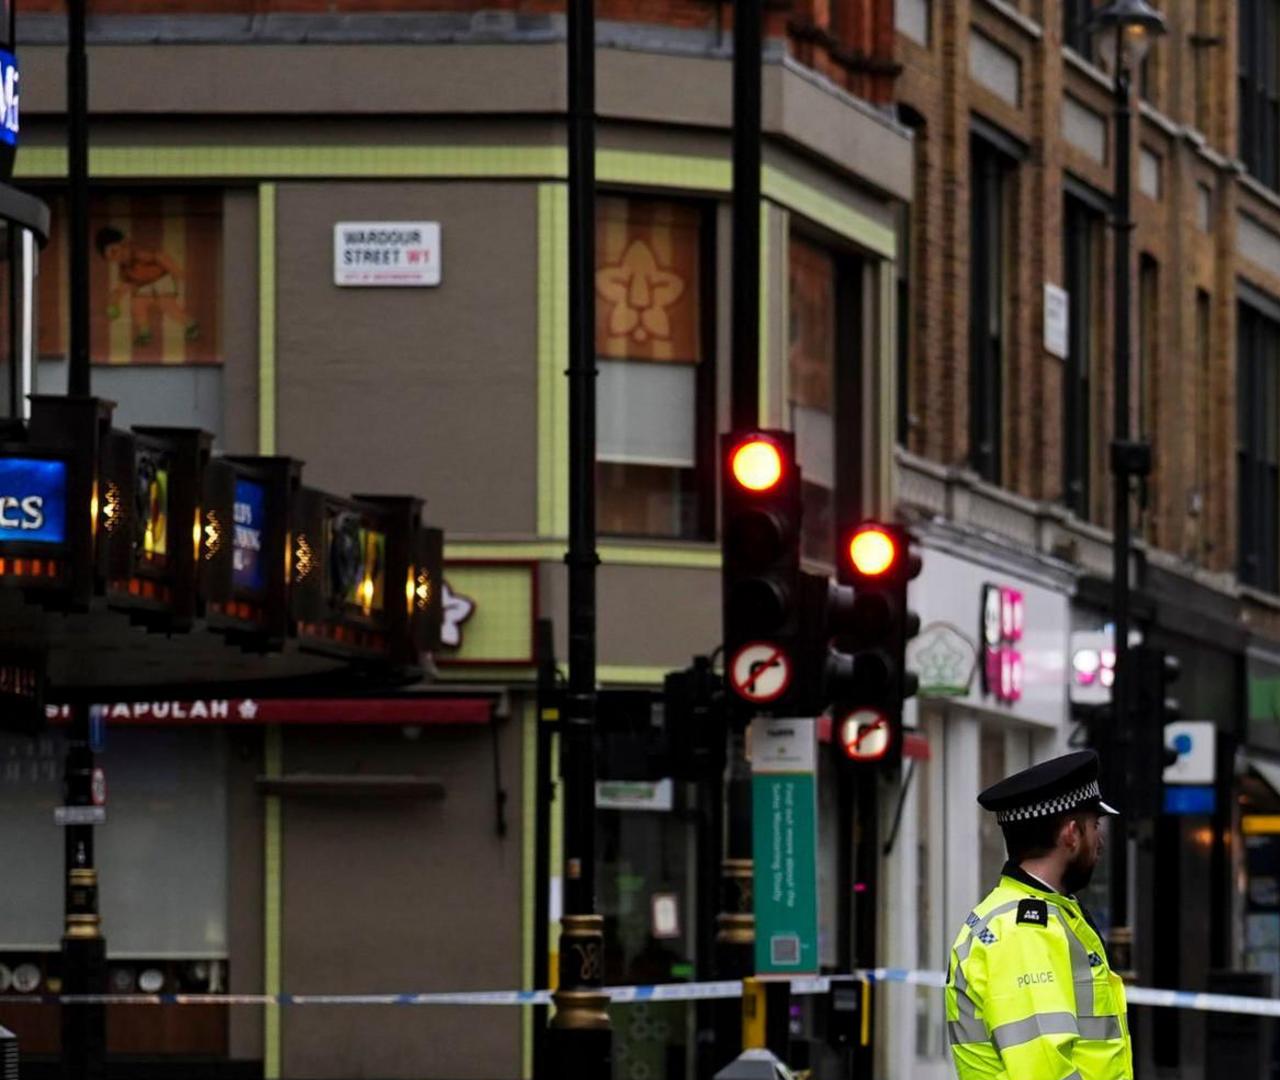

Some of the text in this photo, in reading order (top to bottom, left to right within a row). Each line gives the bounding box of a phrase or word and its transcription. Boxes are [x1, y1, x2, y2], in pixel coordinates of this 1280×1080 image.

[344, 230, 422, 246] WARDOUR
[344, 249, 431, 265] STREET W1
[1017, 971, 1054, 988] POLICE
